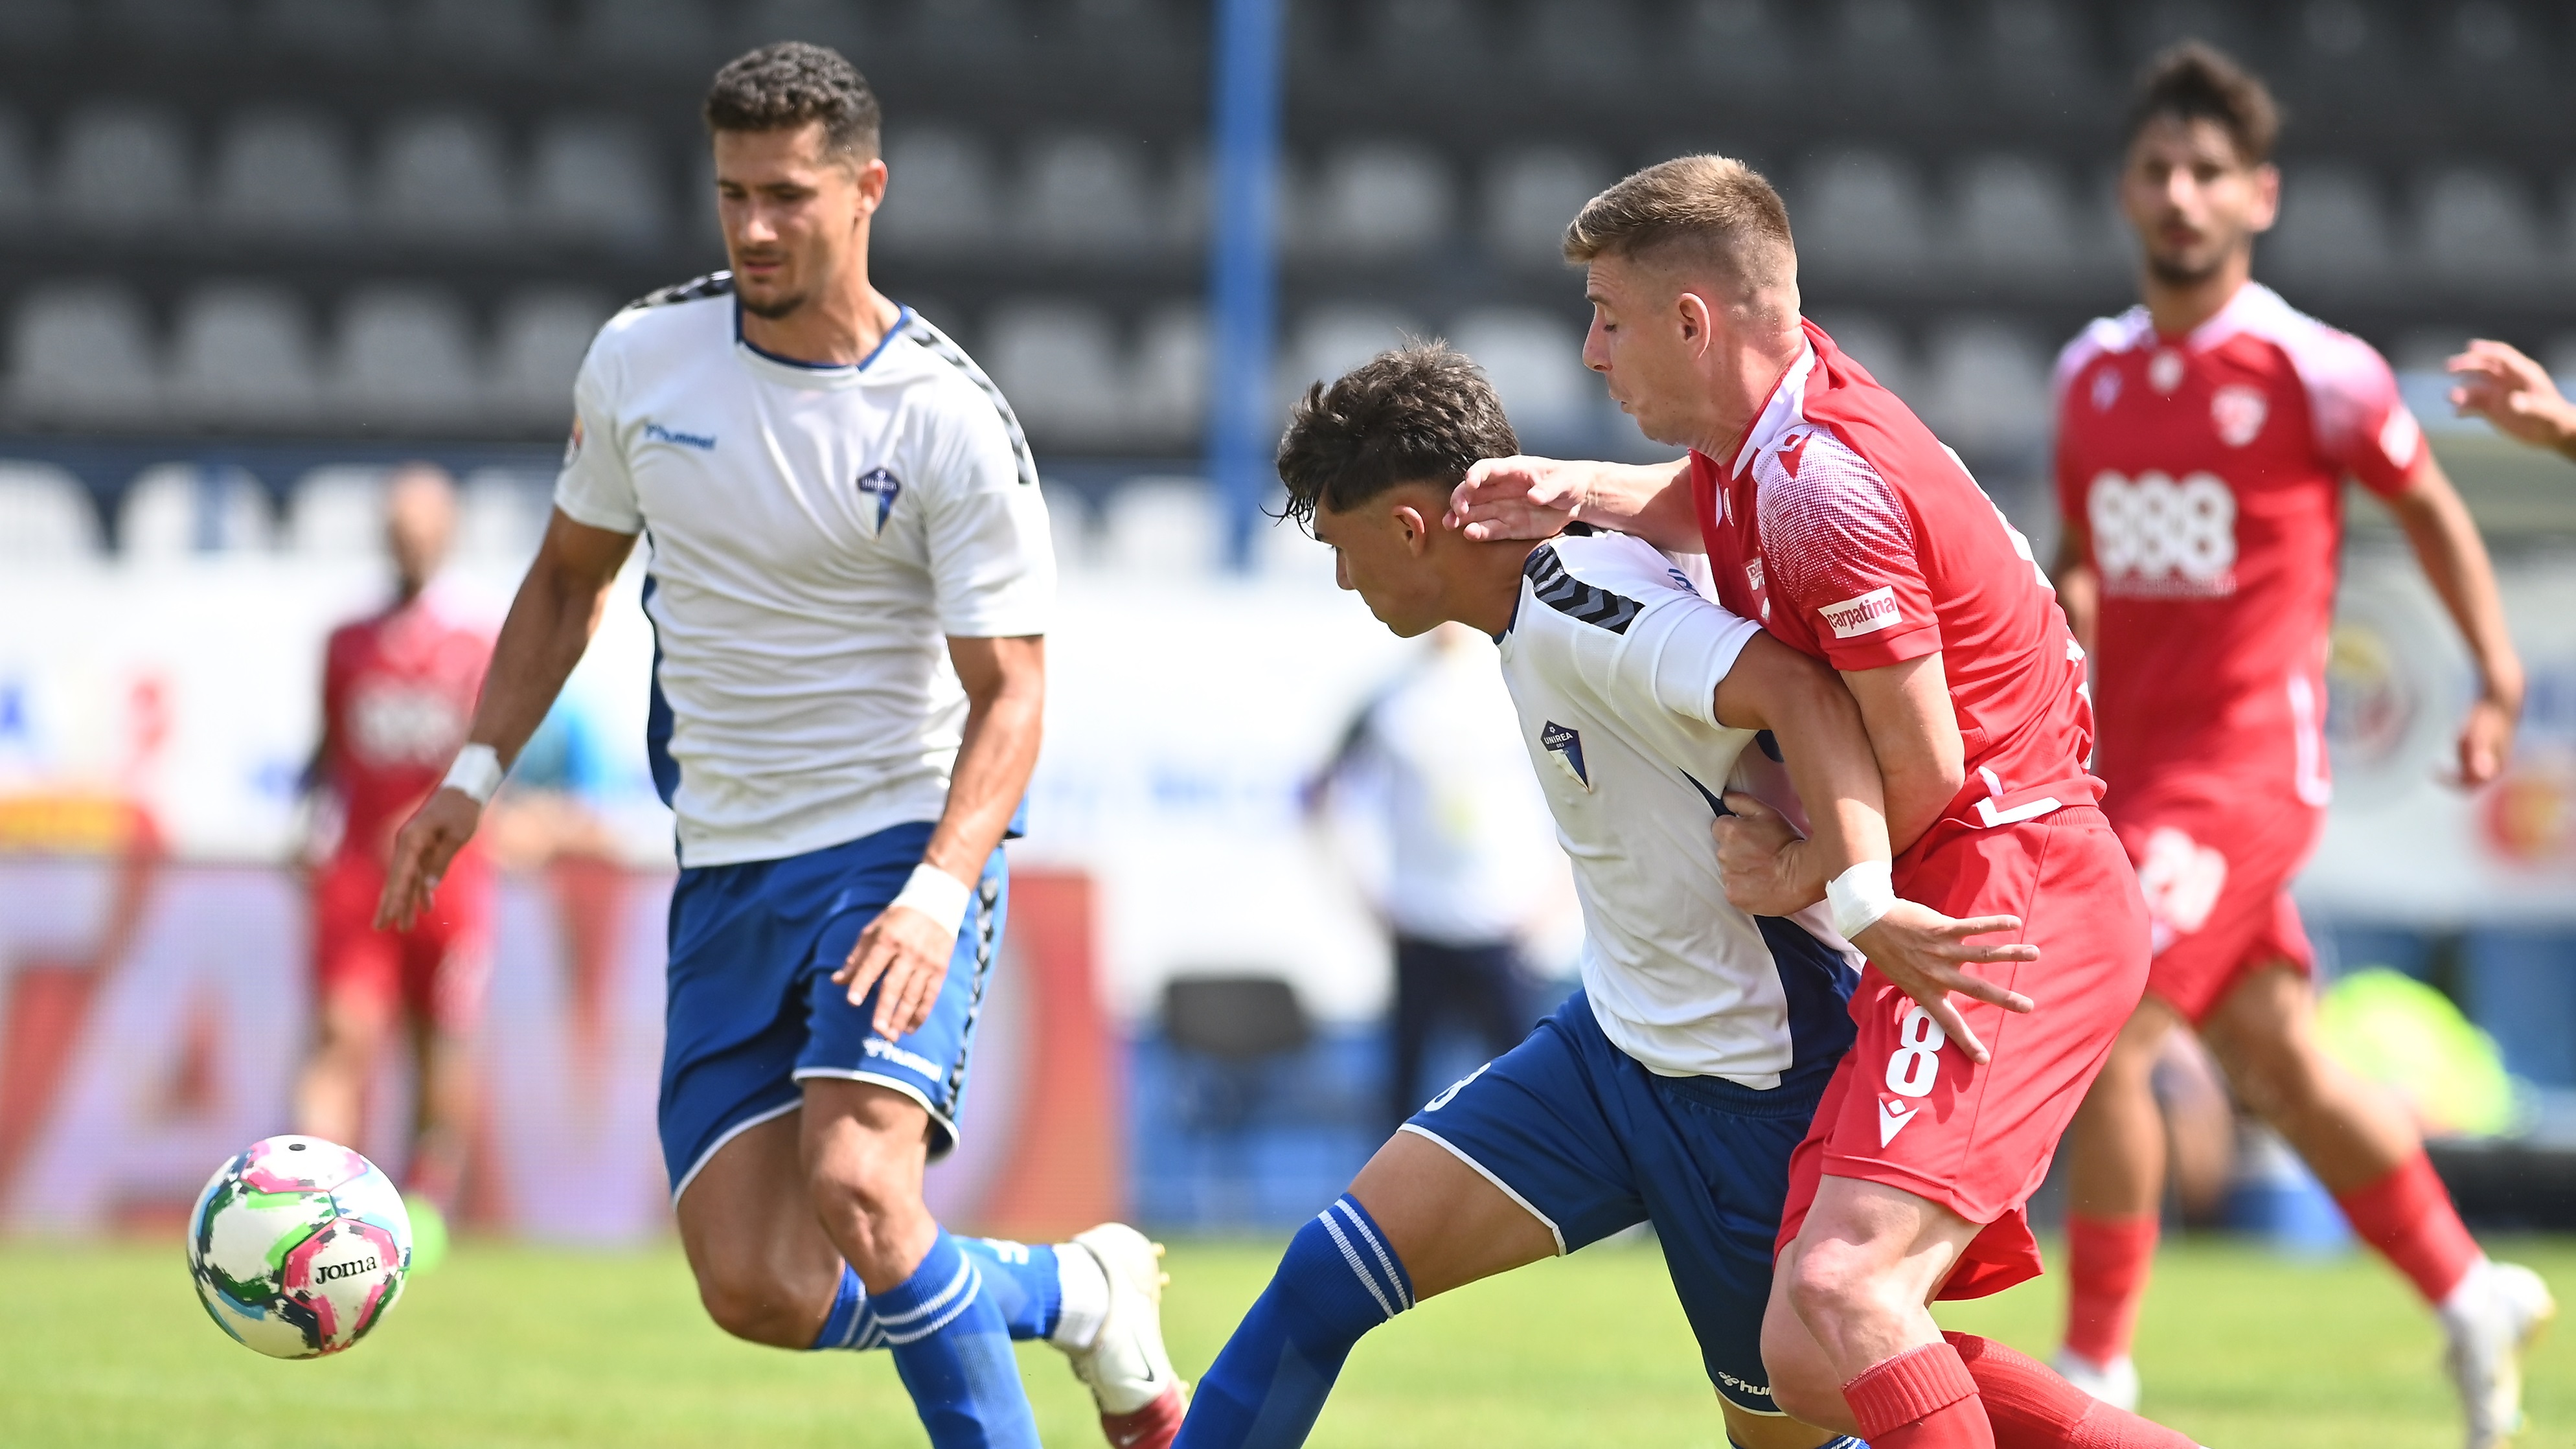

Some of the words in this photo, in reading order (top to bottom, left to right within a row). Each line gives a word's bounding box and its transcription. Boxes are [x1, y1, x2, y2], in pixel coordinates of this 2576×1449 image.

[1827, 597, 1896, 630] carpatina
[1544, 732, 1573, 745] UNIREA
[1886, 1005, 1945, 1097] 8
[315, 1257, 377, 1284] Joma
